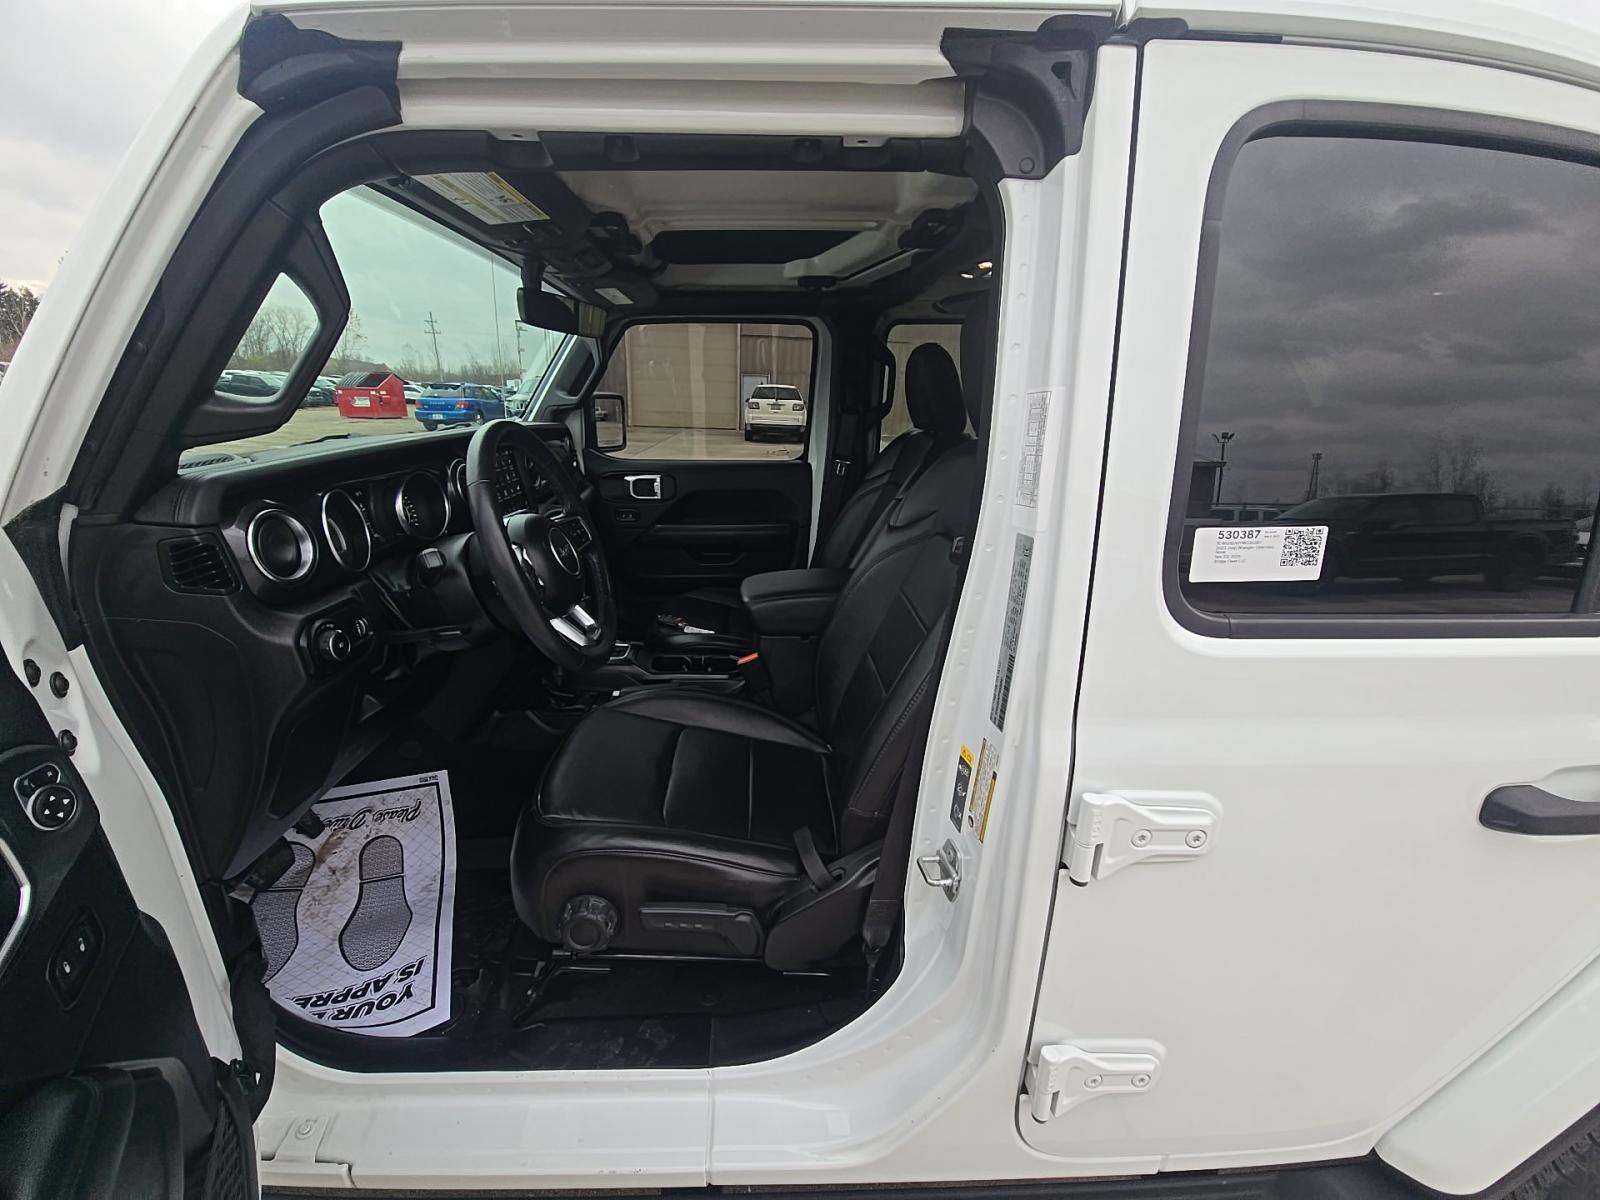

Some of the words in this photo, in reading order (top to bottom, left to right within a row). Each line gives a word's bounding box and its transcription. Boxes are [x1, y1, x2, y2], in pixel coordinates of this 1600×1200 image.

[1218, 530, 1262, 540] 530387
[373, 799, 421, 823] Please
[395, 957, 426, 983] IS
[331, 981, 414, 1021] YOUR
